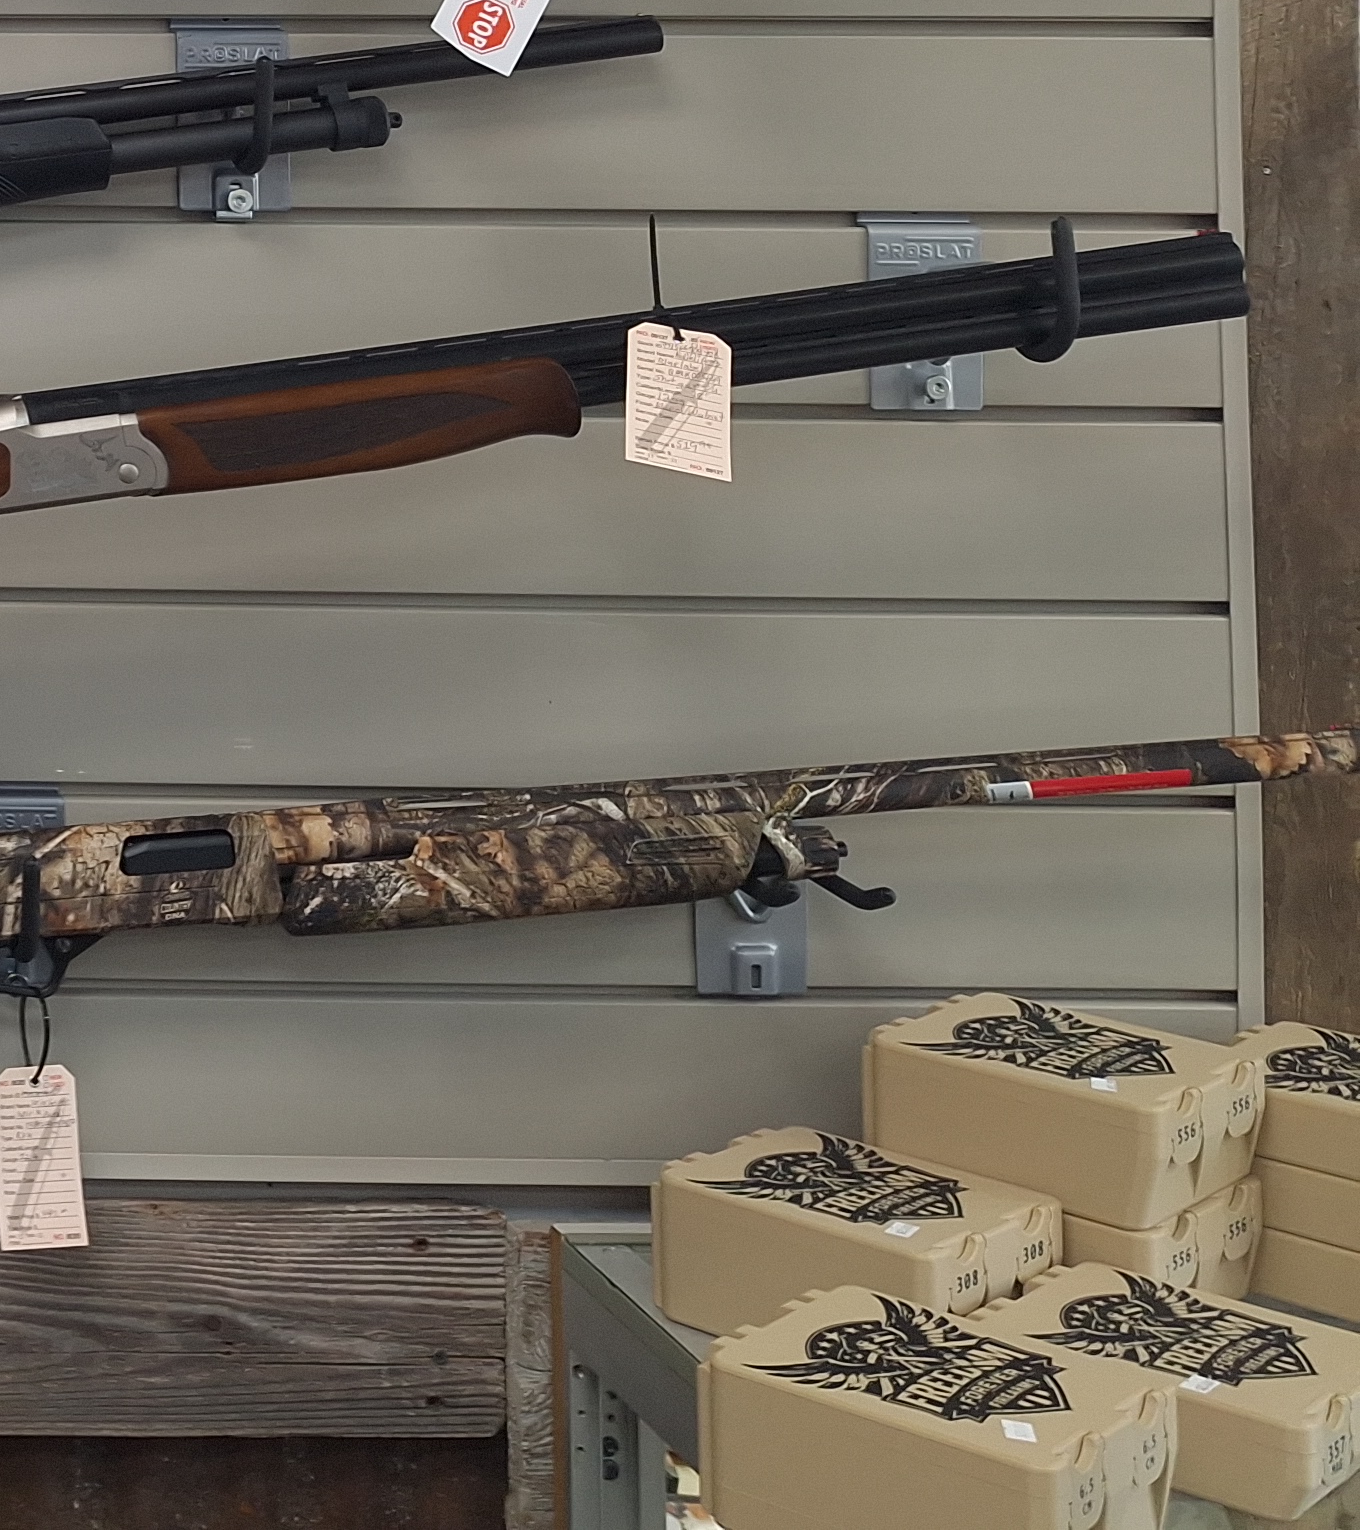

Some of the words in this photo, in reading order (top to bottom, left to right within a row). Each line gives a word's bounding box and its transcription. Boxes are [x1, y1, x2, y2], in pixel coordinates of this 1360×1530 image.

[468, 1, 504, 48] STOP
[876, 243, 974, 259] PROSLAT
[1232, 1095, 1250, 1117] 556
[1177, 1122, 1196, 1145] 556
[1229, 1216, 1247, 1240] 556
[1023, 1240, 1044, 1264] 308
[1172, 1247, 1191, 1271] 556
[957, 1269, 979, 1294] 308
[960, 1368, 1020, 1406] FOREVER
[1328, 1435, 1346, 1464] 357
[1079, 1477, 1094, 1499] 6.5
